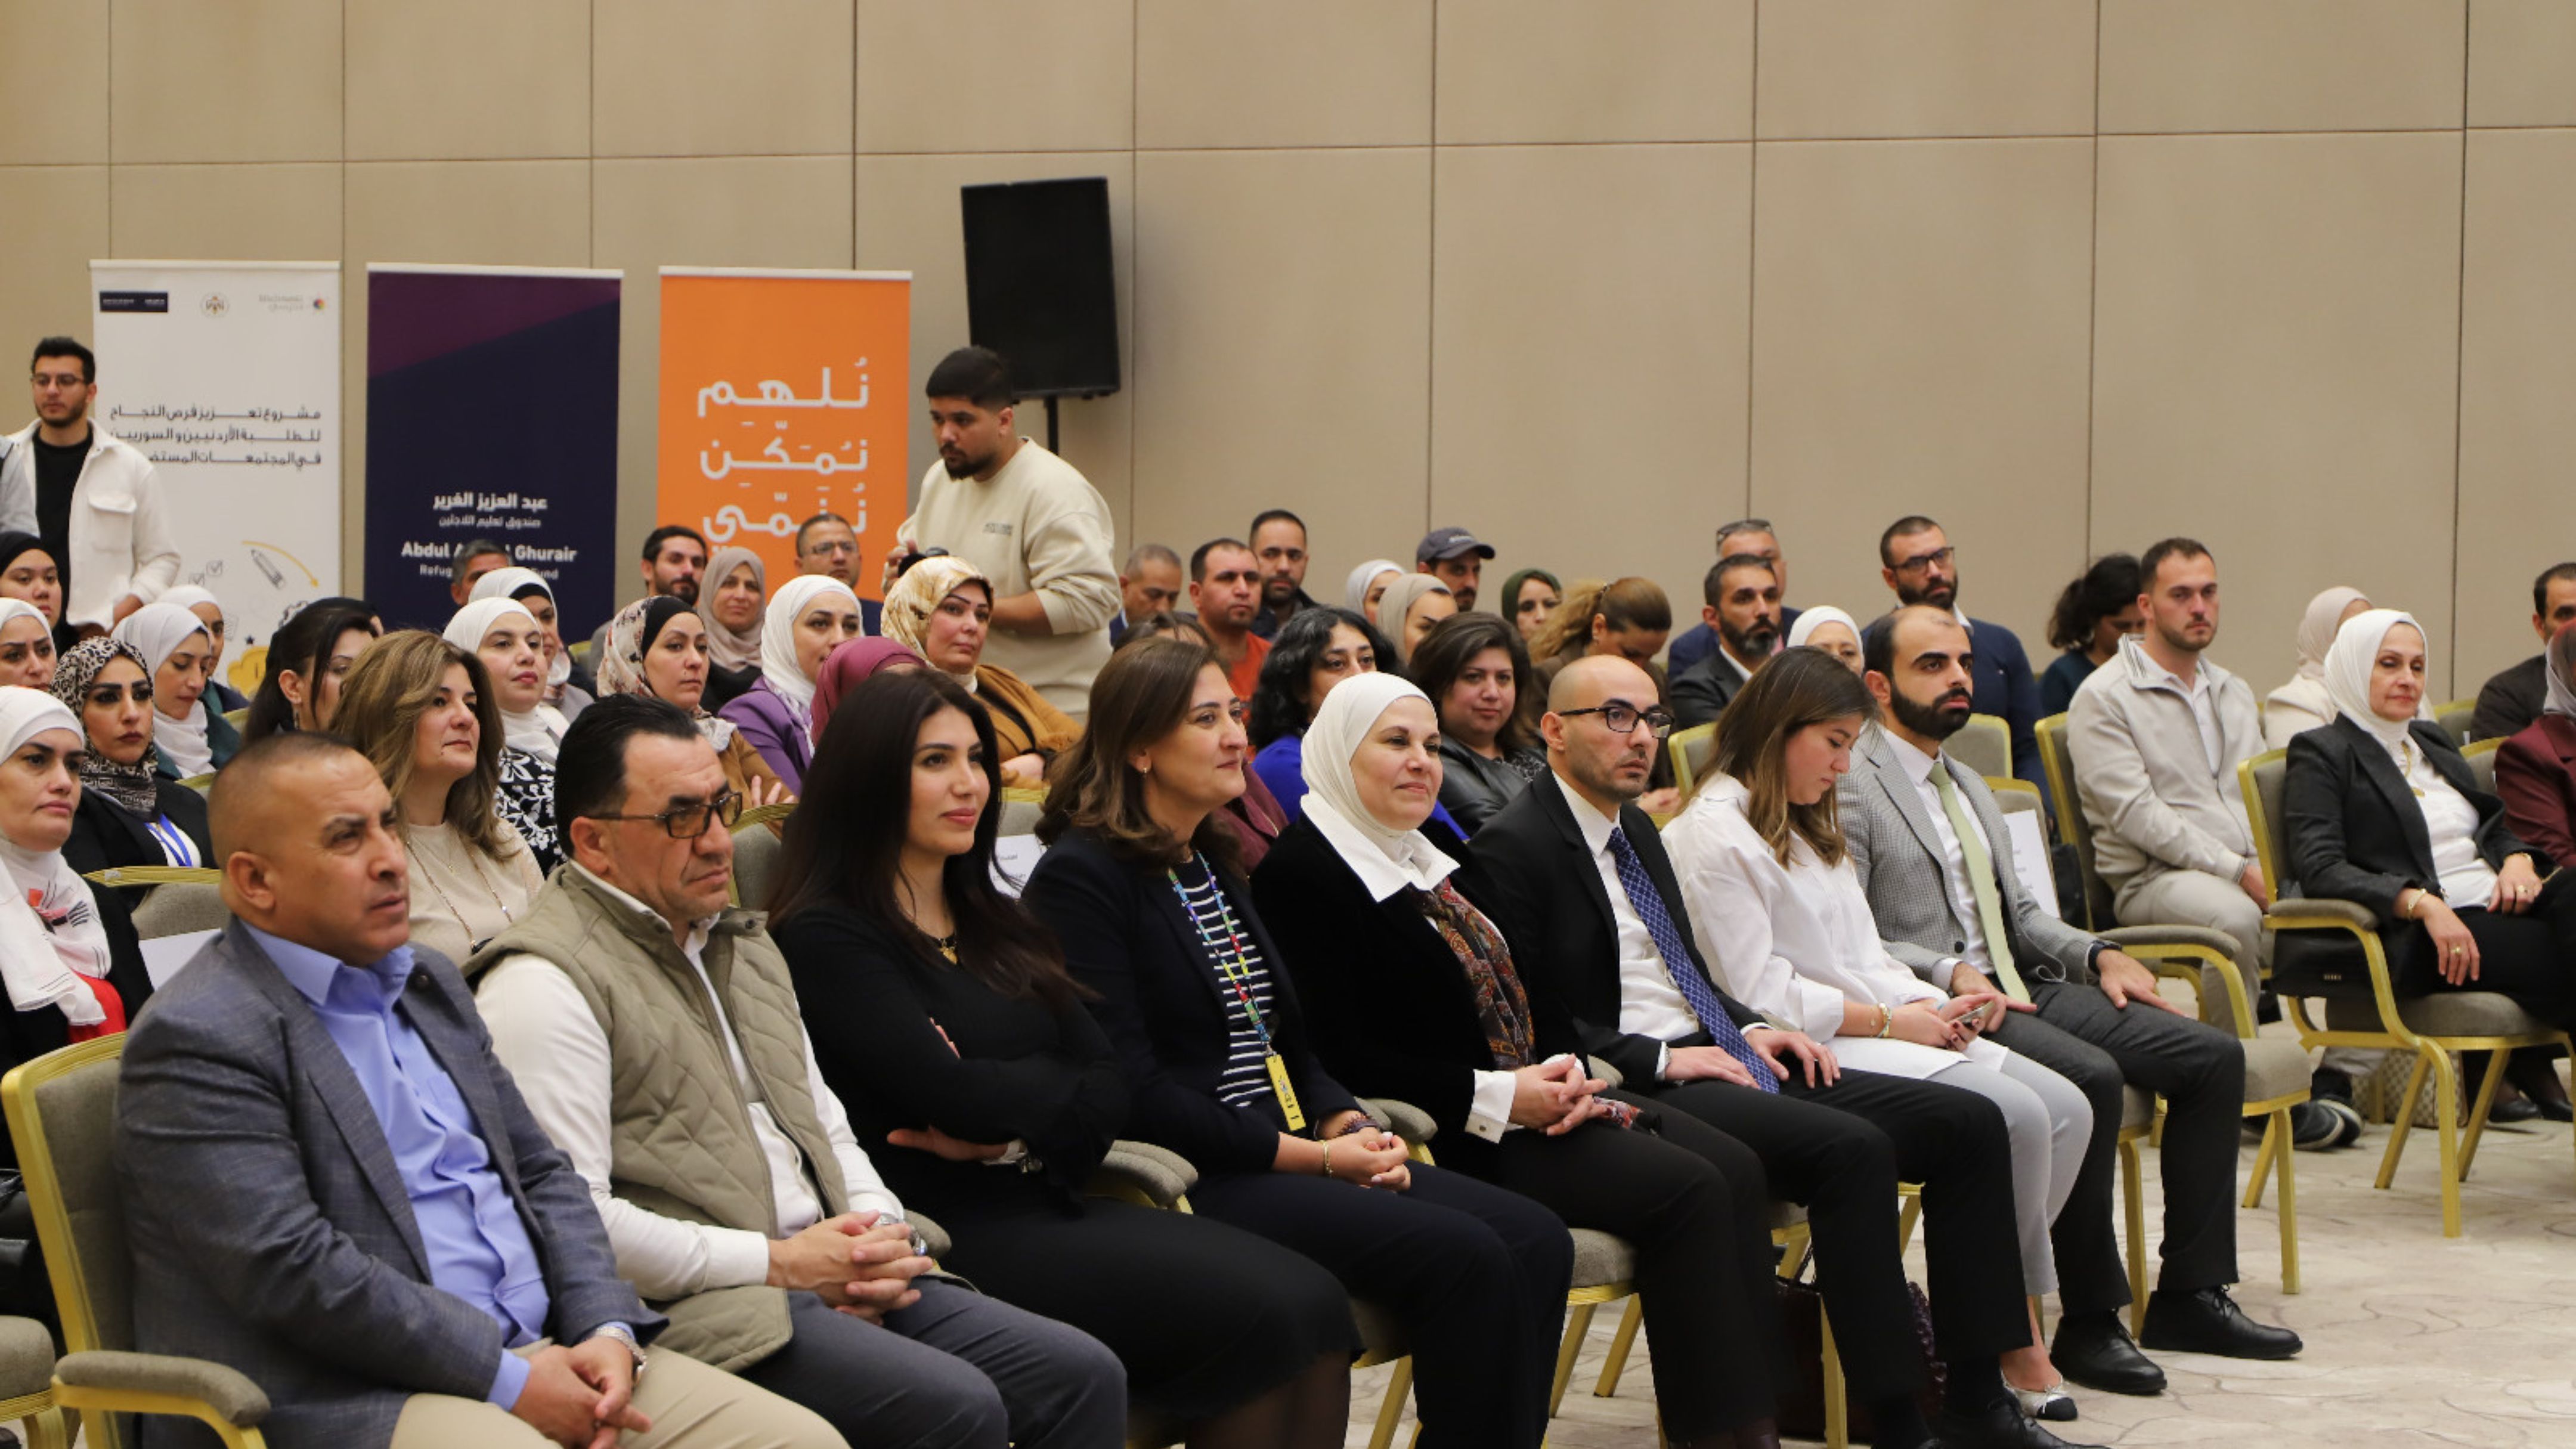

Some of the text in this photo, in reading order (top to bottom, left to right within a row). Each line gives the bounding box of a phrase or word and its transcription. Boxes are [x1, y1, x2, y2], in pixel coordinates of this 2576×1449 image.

[110, 404, 165, 421] النجاح
[166, 402, 197, 420] فرص
[264, 404, 321, 422] مشروع
[241, 427, 321, 443] للطلبة
[149, 450, 321, 471] في المجتمعات المستض
[476, 492, 518, 512] العزيز
[521, 496, 548, 513] عبد
[476, 515, 504, 528] تعليم
[505, 516, 541, 530] صندوق
[401, 540, 450, 558] Abdul
[515, 543, 578, 562] Ghurair
[420, 564, 559, 580] Refug und
